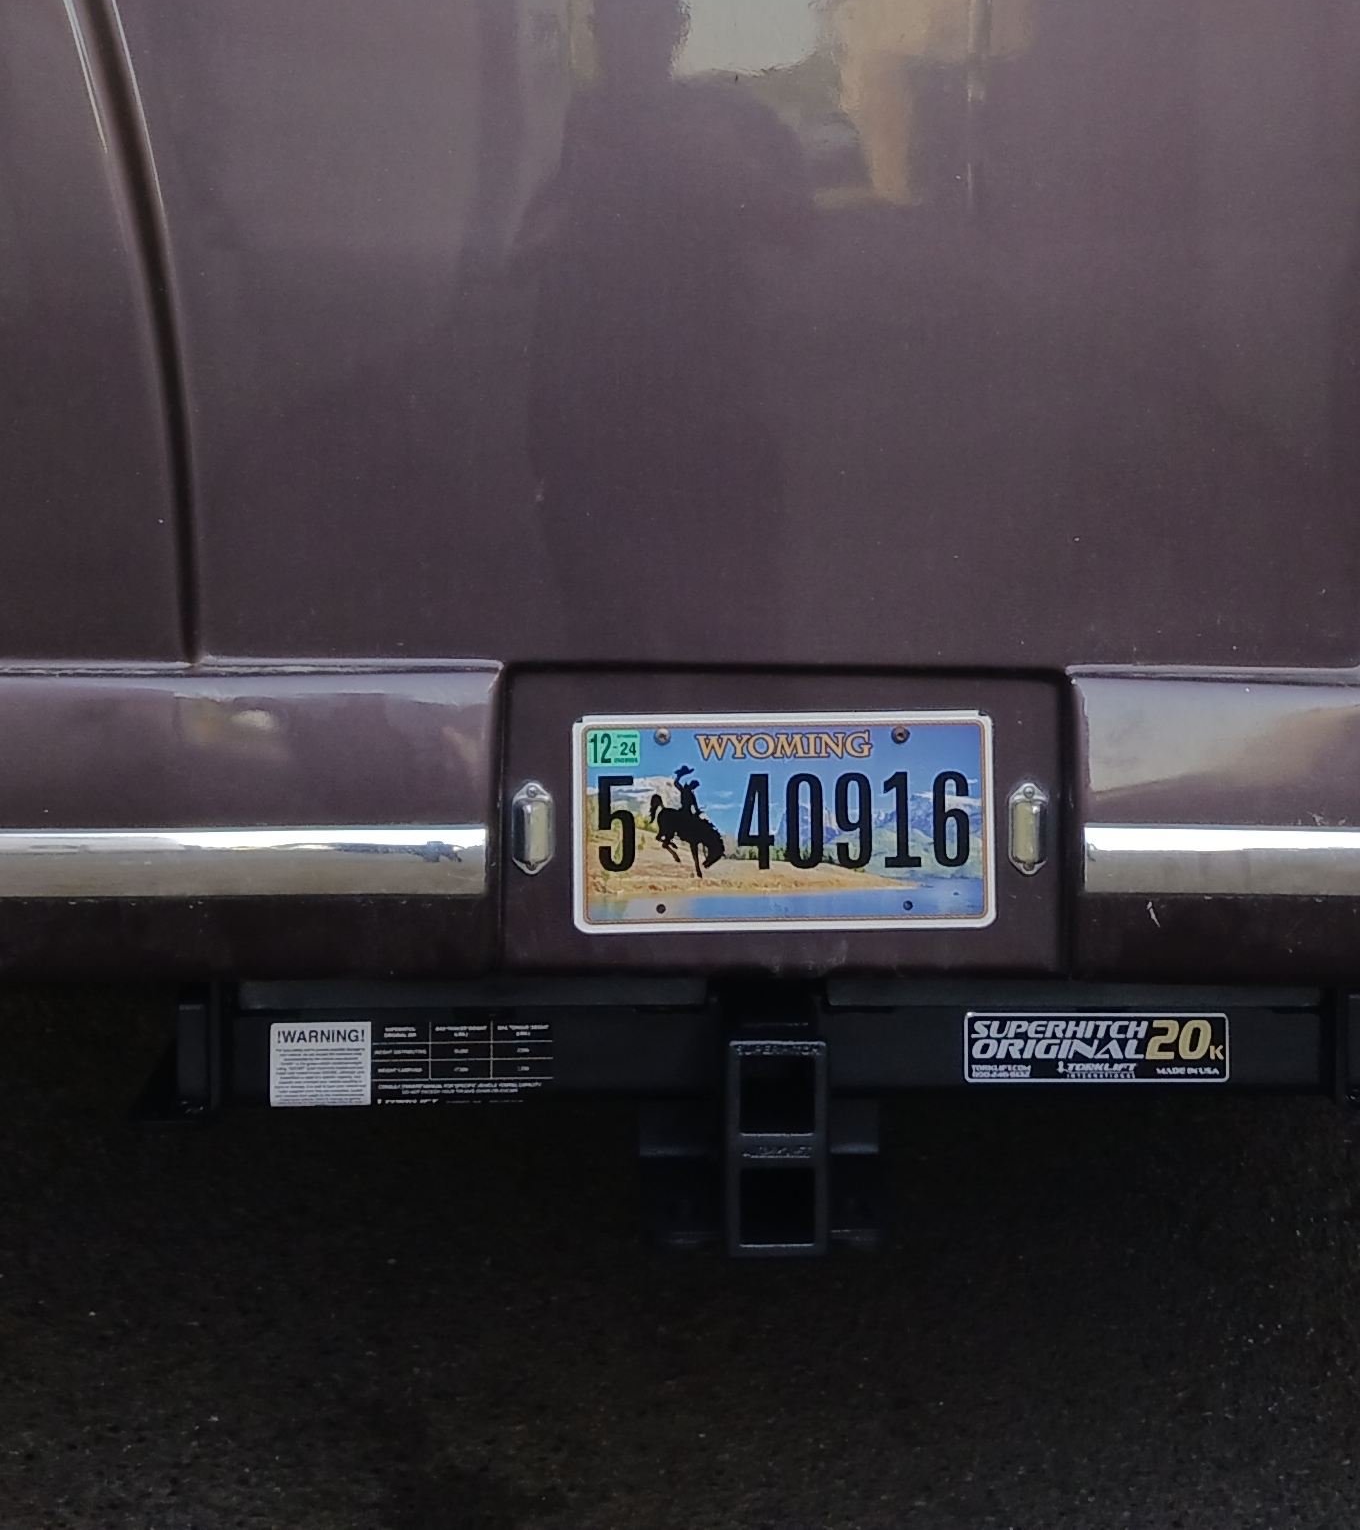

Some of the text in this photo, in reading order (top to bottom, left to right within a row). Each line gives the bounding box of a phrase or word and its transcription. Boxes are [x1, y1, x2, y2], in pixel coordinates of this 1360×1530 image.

[696, 730, 872, 760] WYOMING
[597, 771, 970, 872] 5 40916
[277, 1029, 365, 1043] !WARNING!
[971, 1020, 1148, 1039] SUPERHITCH
[971, 1039, 1147, 1059] ORIGINAL
[1067, 1063, 1137, 1072] TORKLIFT
[1156, 1067, 1185, 1075] MADE
[1199, 1067, 1220, 1075] USA
